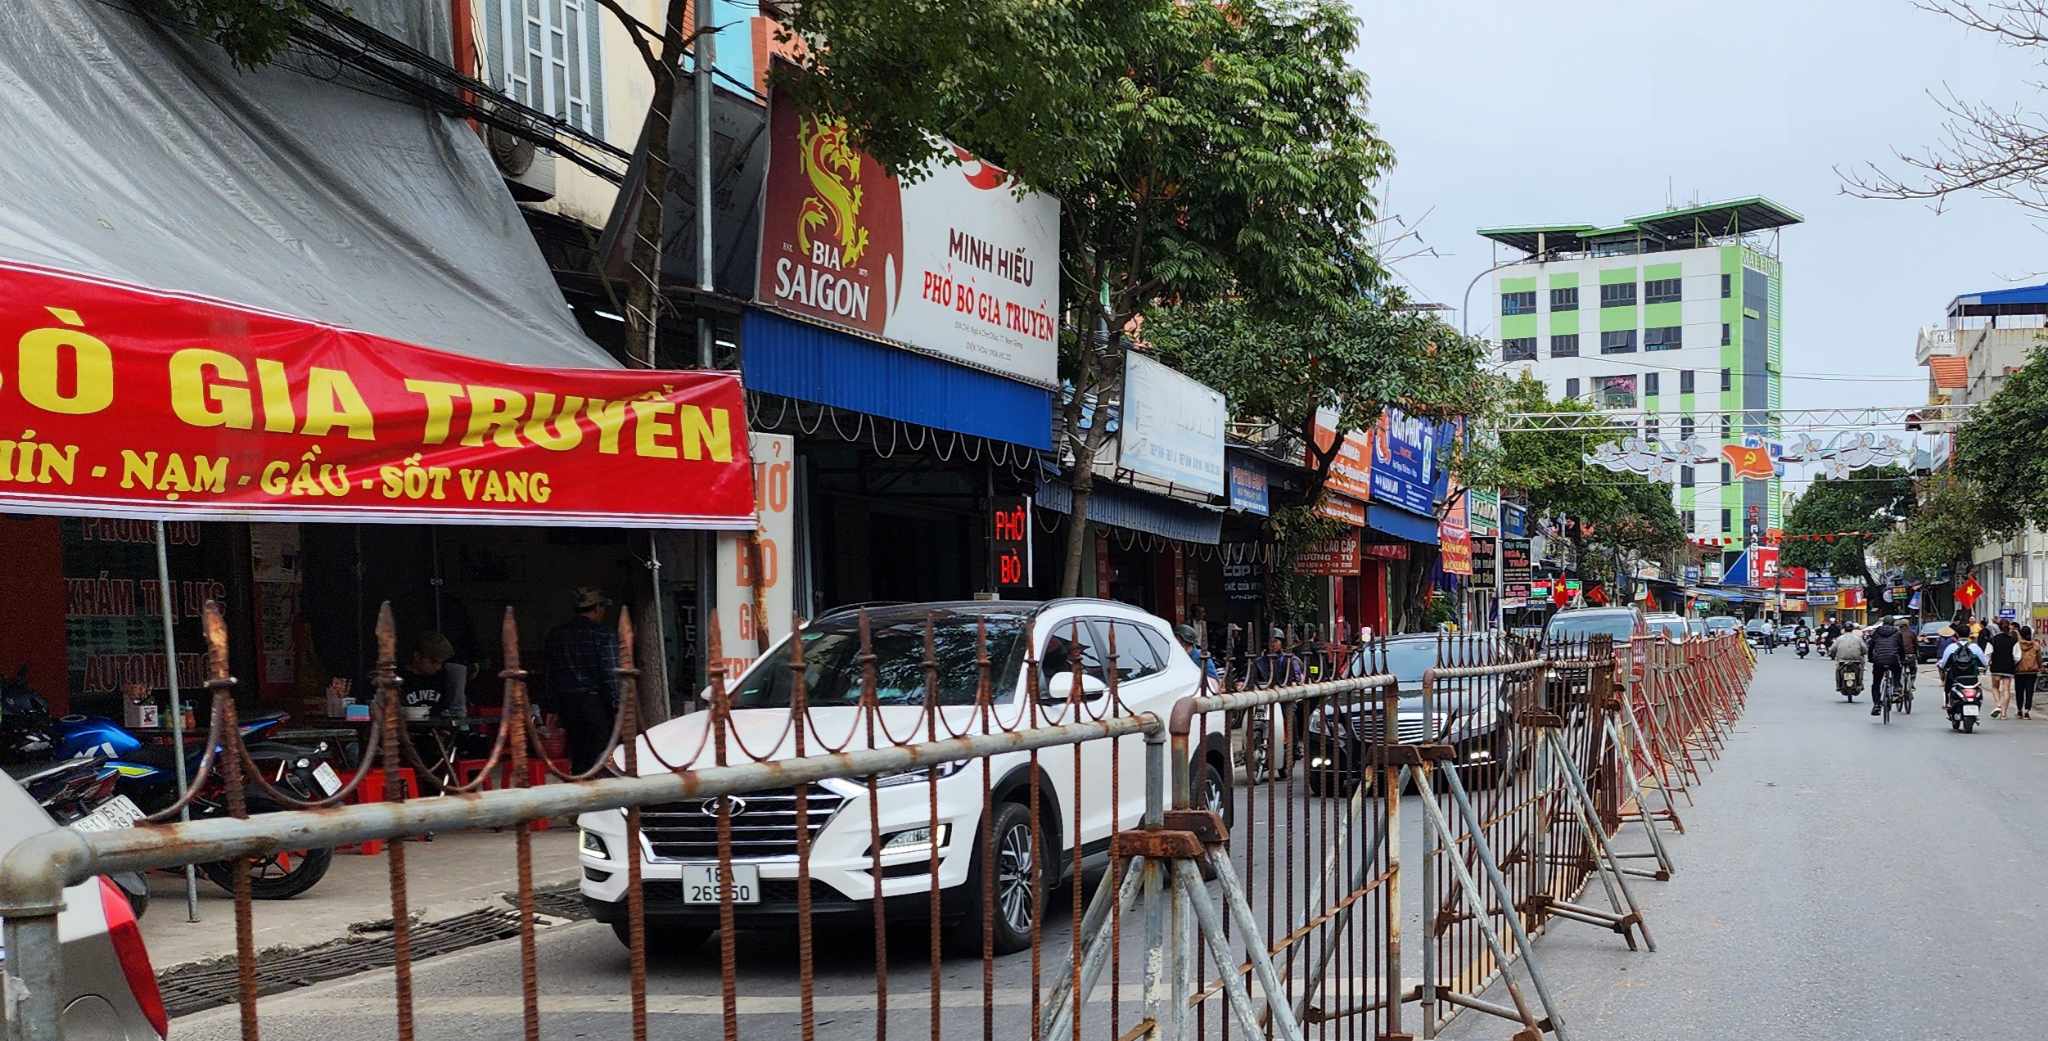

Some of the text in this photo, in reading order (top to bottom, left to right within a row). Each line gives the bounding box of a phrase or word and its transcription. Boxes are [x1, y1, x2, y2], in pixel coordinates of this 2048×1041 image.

[812, 240, 841, 272] BIA
[949, 227, 993, 273] MINH
[775, 257, 870, 321] SAIGON
[922, 263, 953, 307] PHỞ
[956, 277, 976, 315] BÒ
[978, 293, 1001, 326] GIA
[1005, 299, 1055, 342] TRUYỀN
[0, 306, 733, 463] Ò GIA TRUYỀN
[120, 449, 230, 500] NẠM
[260, 444, 350, 497] GẦU
[379, 453, 452, 499] SỐT
[459, 467, 552, 503] VANG
[995, 505, 1025, 541] PHỞ
[1000, 547, 1022, 584] BÒ
